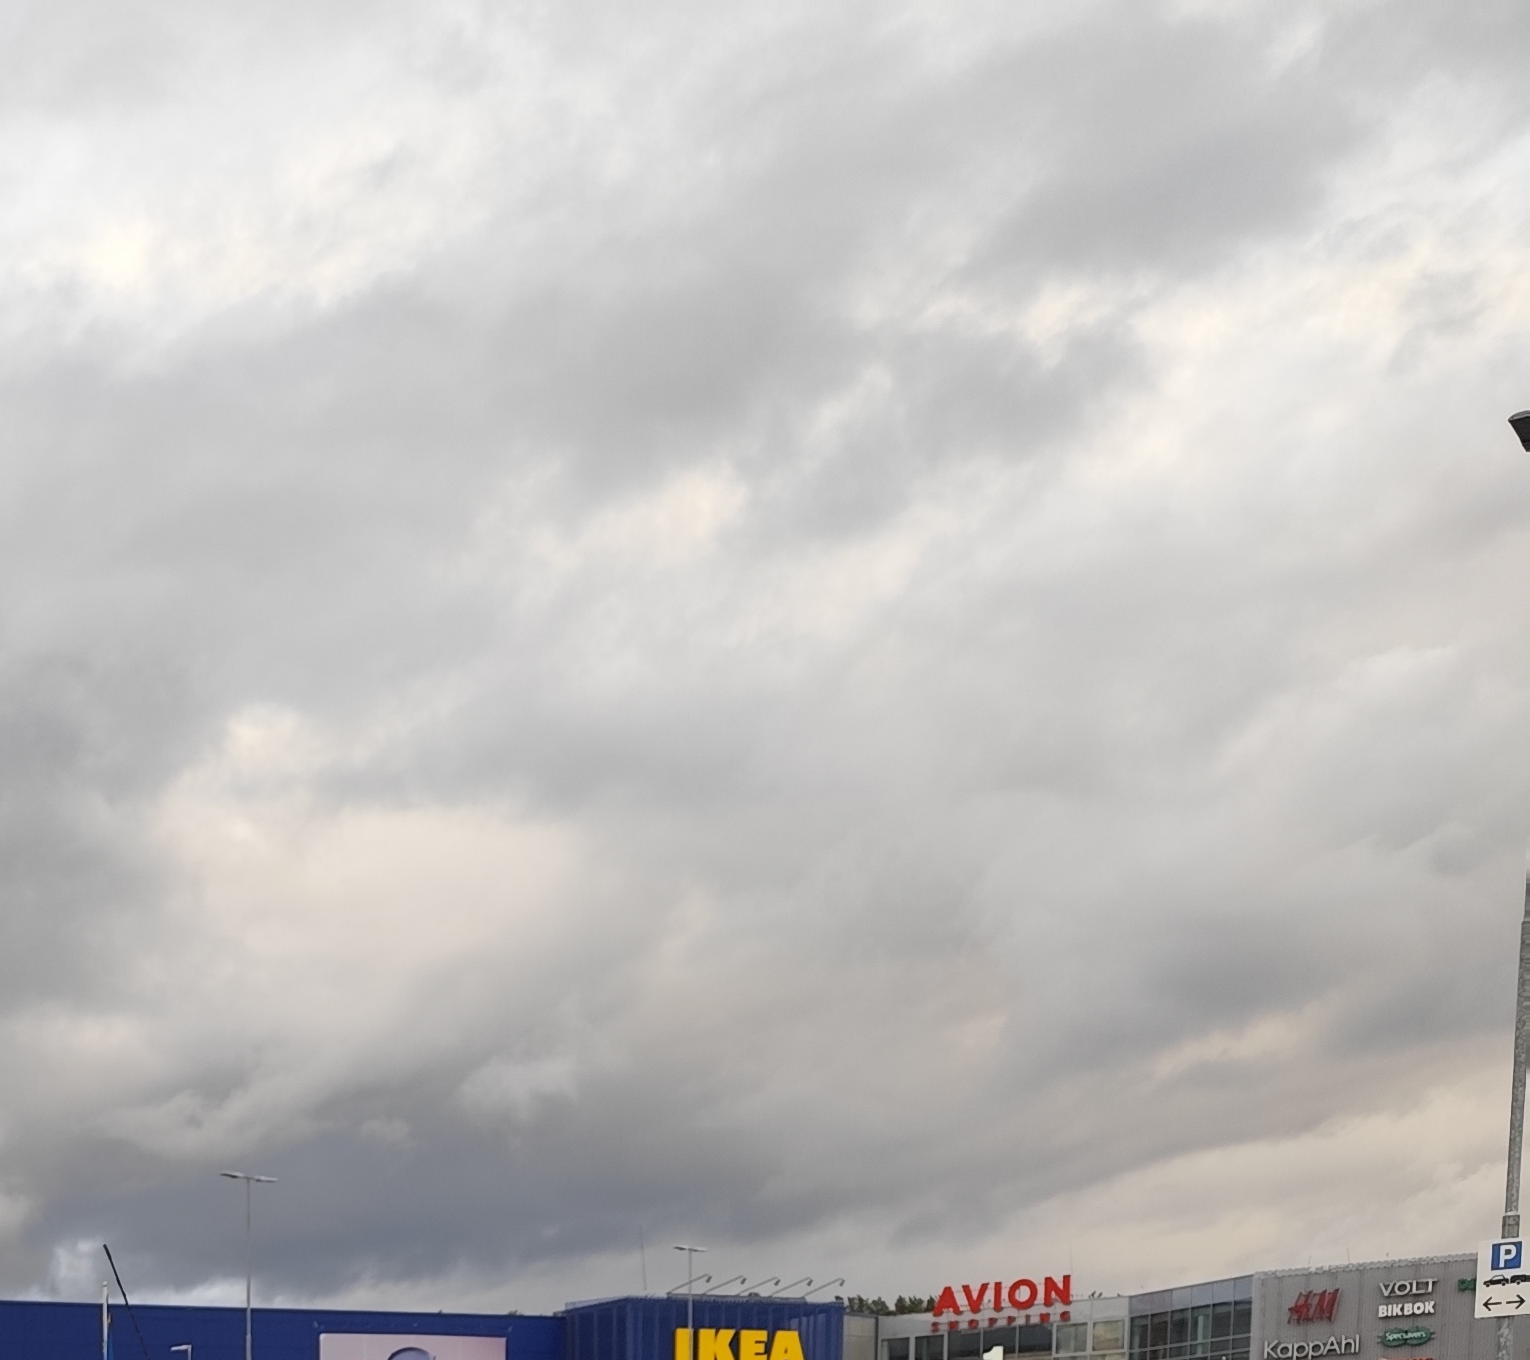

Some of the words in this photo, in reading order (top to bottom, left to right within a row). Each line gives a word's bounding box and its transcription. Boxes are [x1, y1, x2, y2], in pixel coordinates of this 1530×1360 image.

[1499, 1244, 1517, 1268] P
[933, 1274, 1071, 1317] AVION
[1379, 1278, 1438, 1297] VOLT
